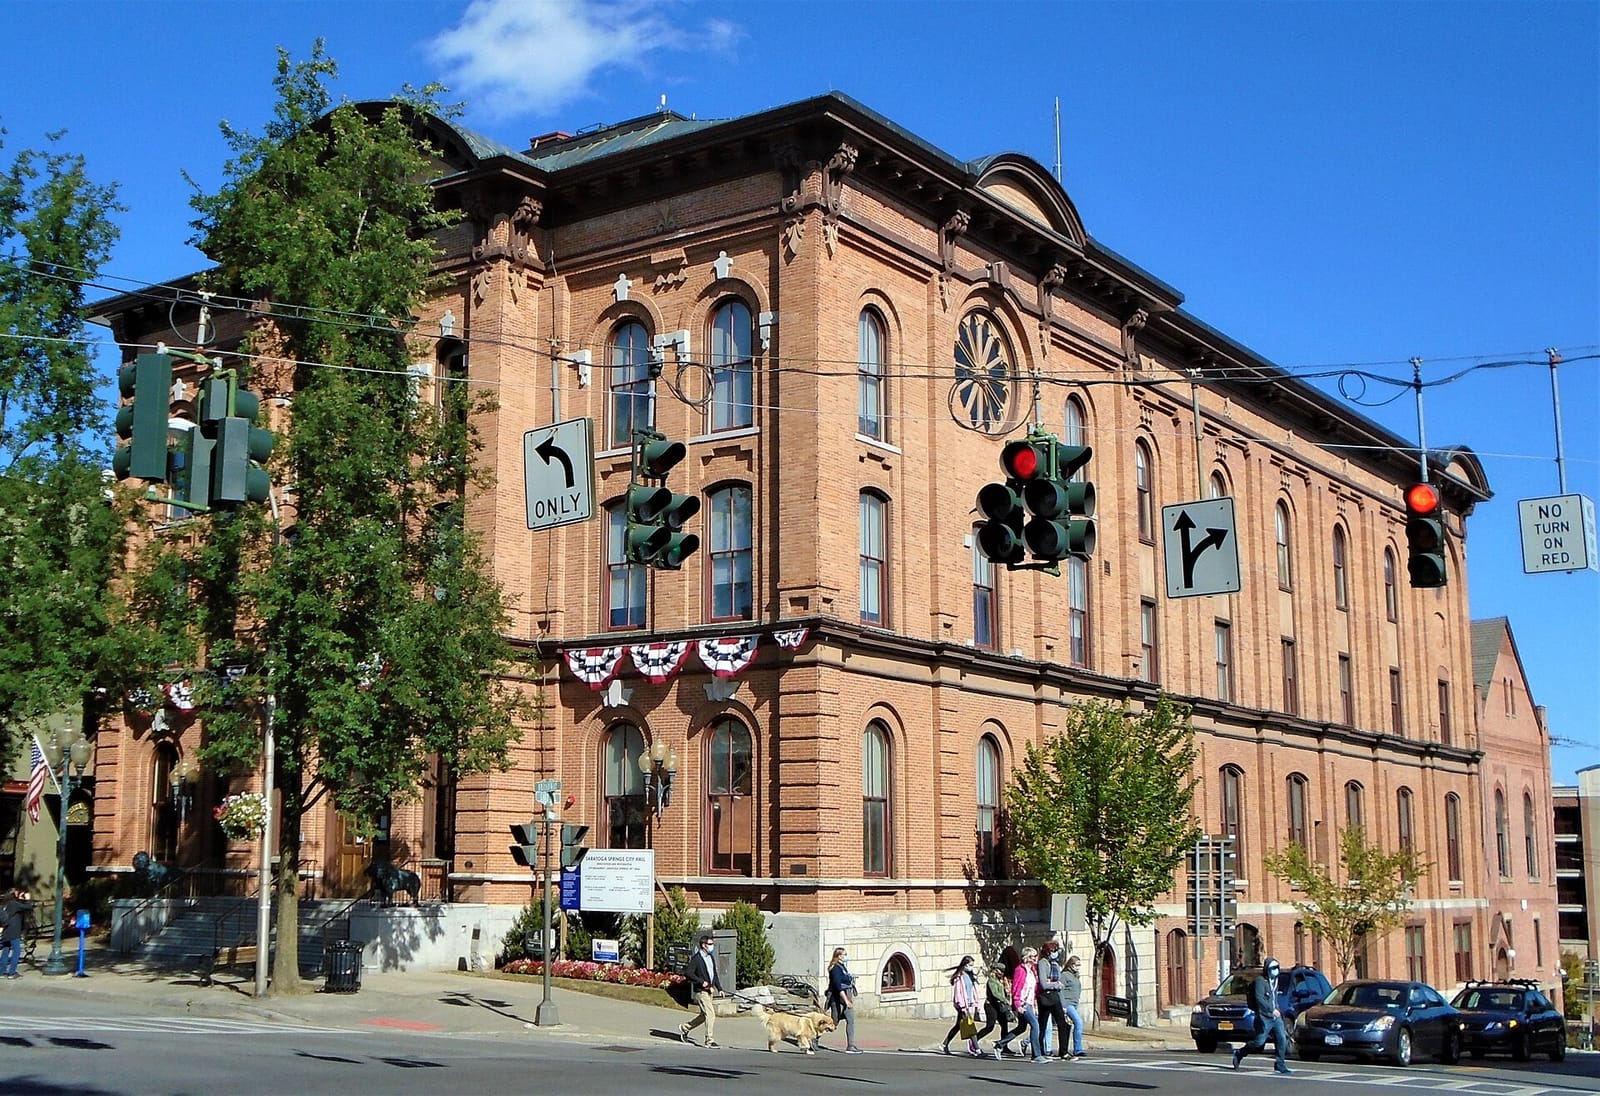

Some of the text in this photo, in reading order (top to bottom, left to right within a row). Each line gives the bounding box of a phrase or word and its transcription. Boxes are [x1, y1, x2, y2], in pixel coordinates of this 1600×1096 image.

[535, 492, 581, 518] ONLY
[1538, 504, 1562, 519] NO
[1534, 521, 1570, 535] TURN
[1543, 537, 1563, 550] ON
[1542, 552, 1570, 565] RED
